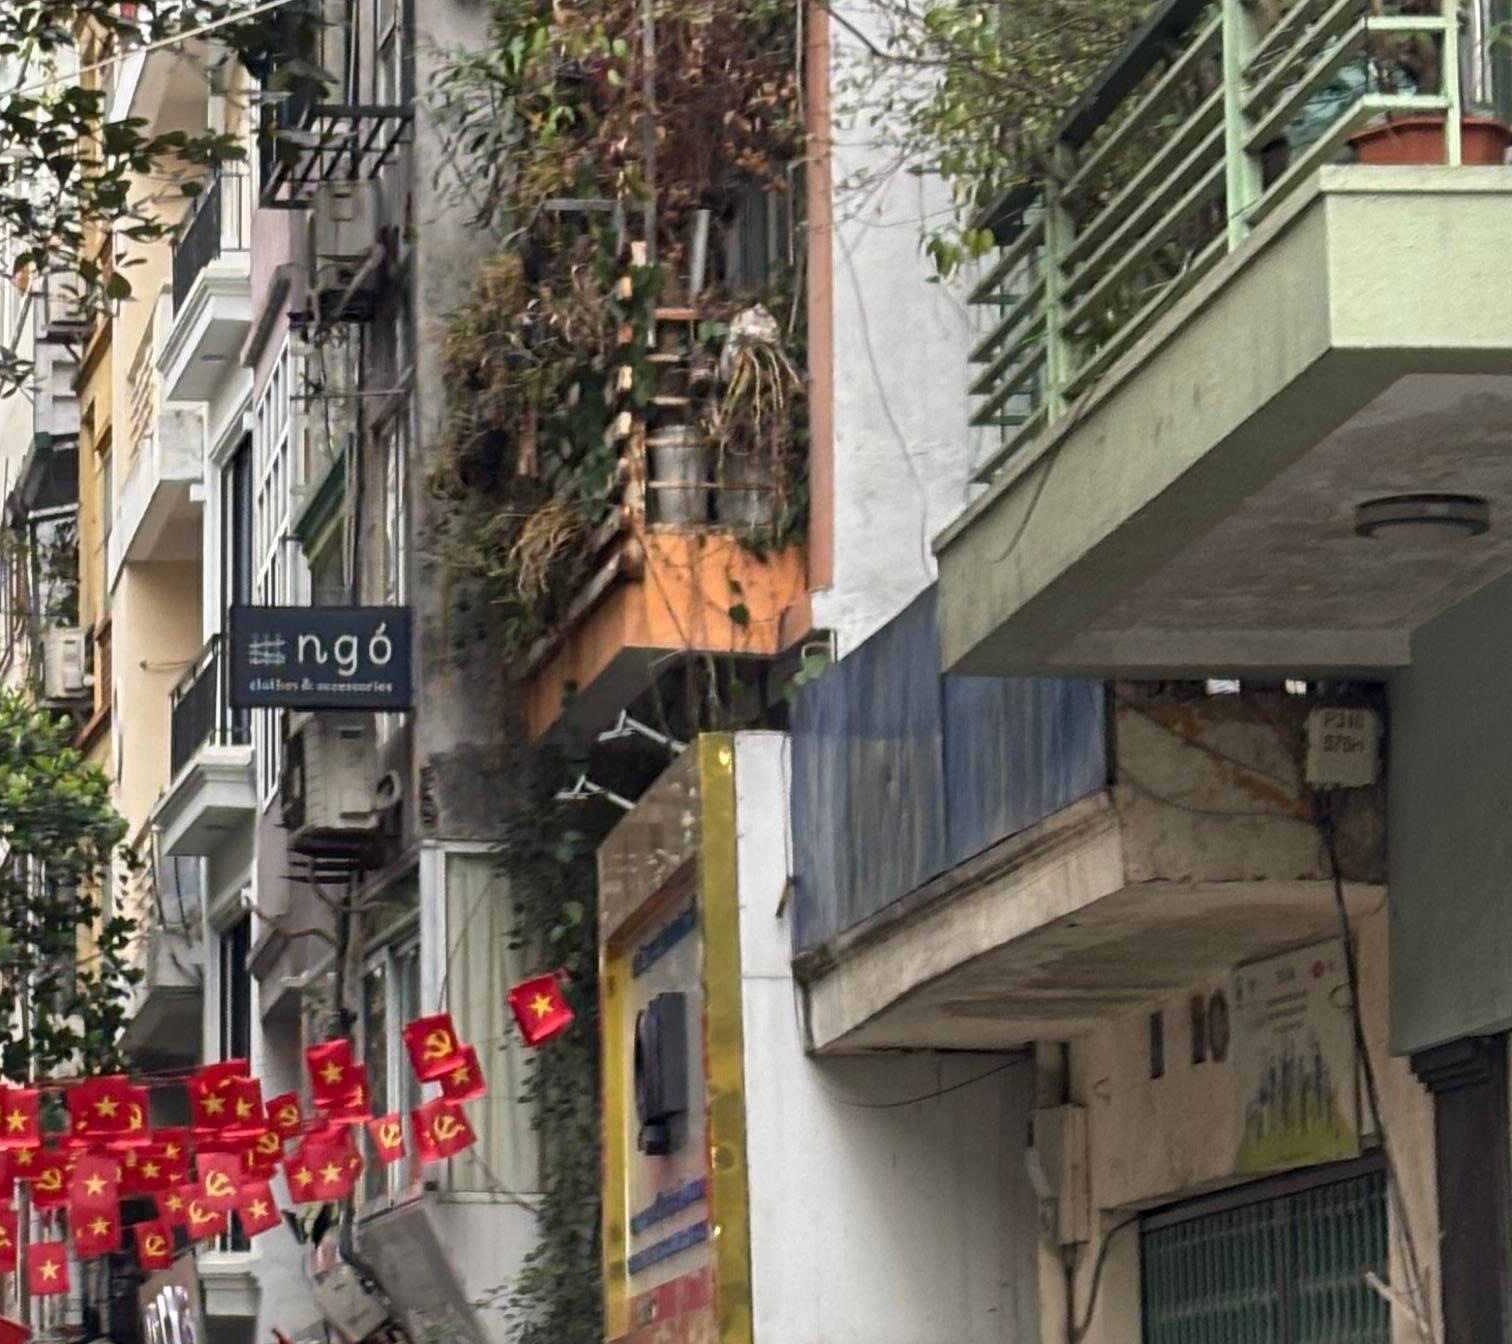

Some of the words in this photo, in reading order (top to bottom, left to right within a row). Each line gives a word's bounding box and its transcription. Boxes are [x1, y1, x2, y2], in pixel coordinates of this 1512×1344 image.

[297, 620, 393, 677] ngó
[248, 677, 298, 692] clothes
[301, 678, 314, 692] &
[316, 680, 393, 693] accessories
